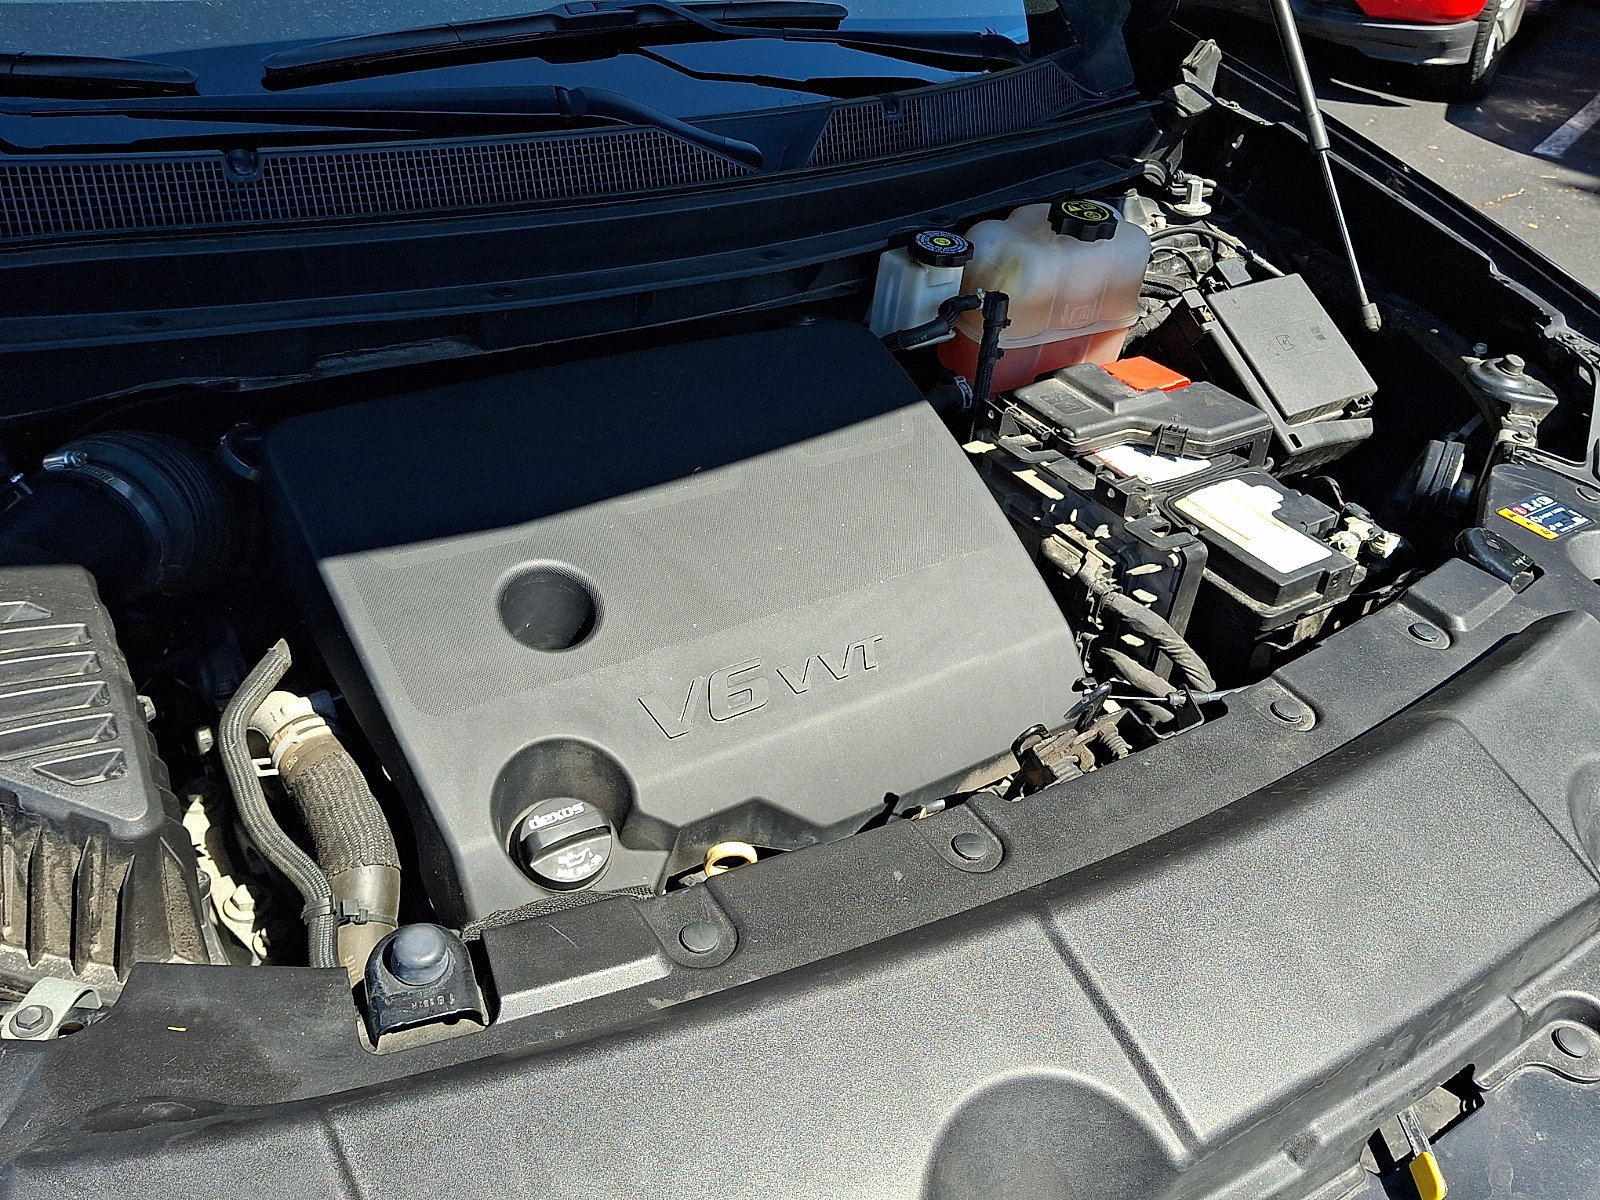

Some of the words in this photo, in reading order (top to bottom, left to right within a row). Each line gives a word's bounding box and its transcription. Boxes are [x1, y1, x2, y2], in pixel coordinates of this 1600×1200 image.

[637, 657, 769, 739] V6
[775, 633, 883, 695] VVT
[528, 801, 585, 830] dexos
